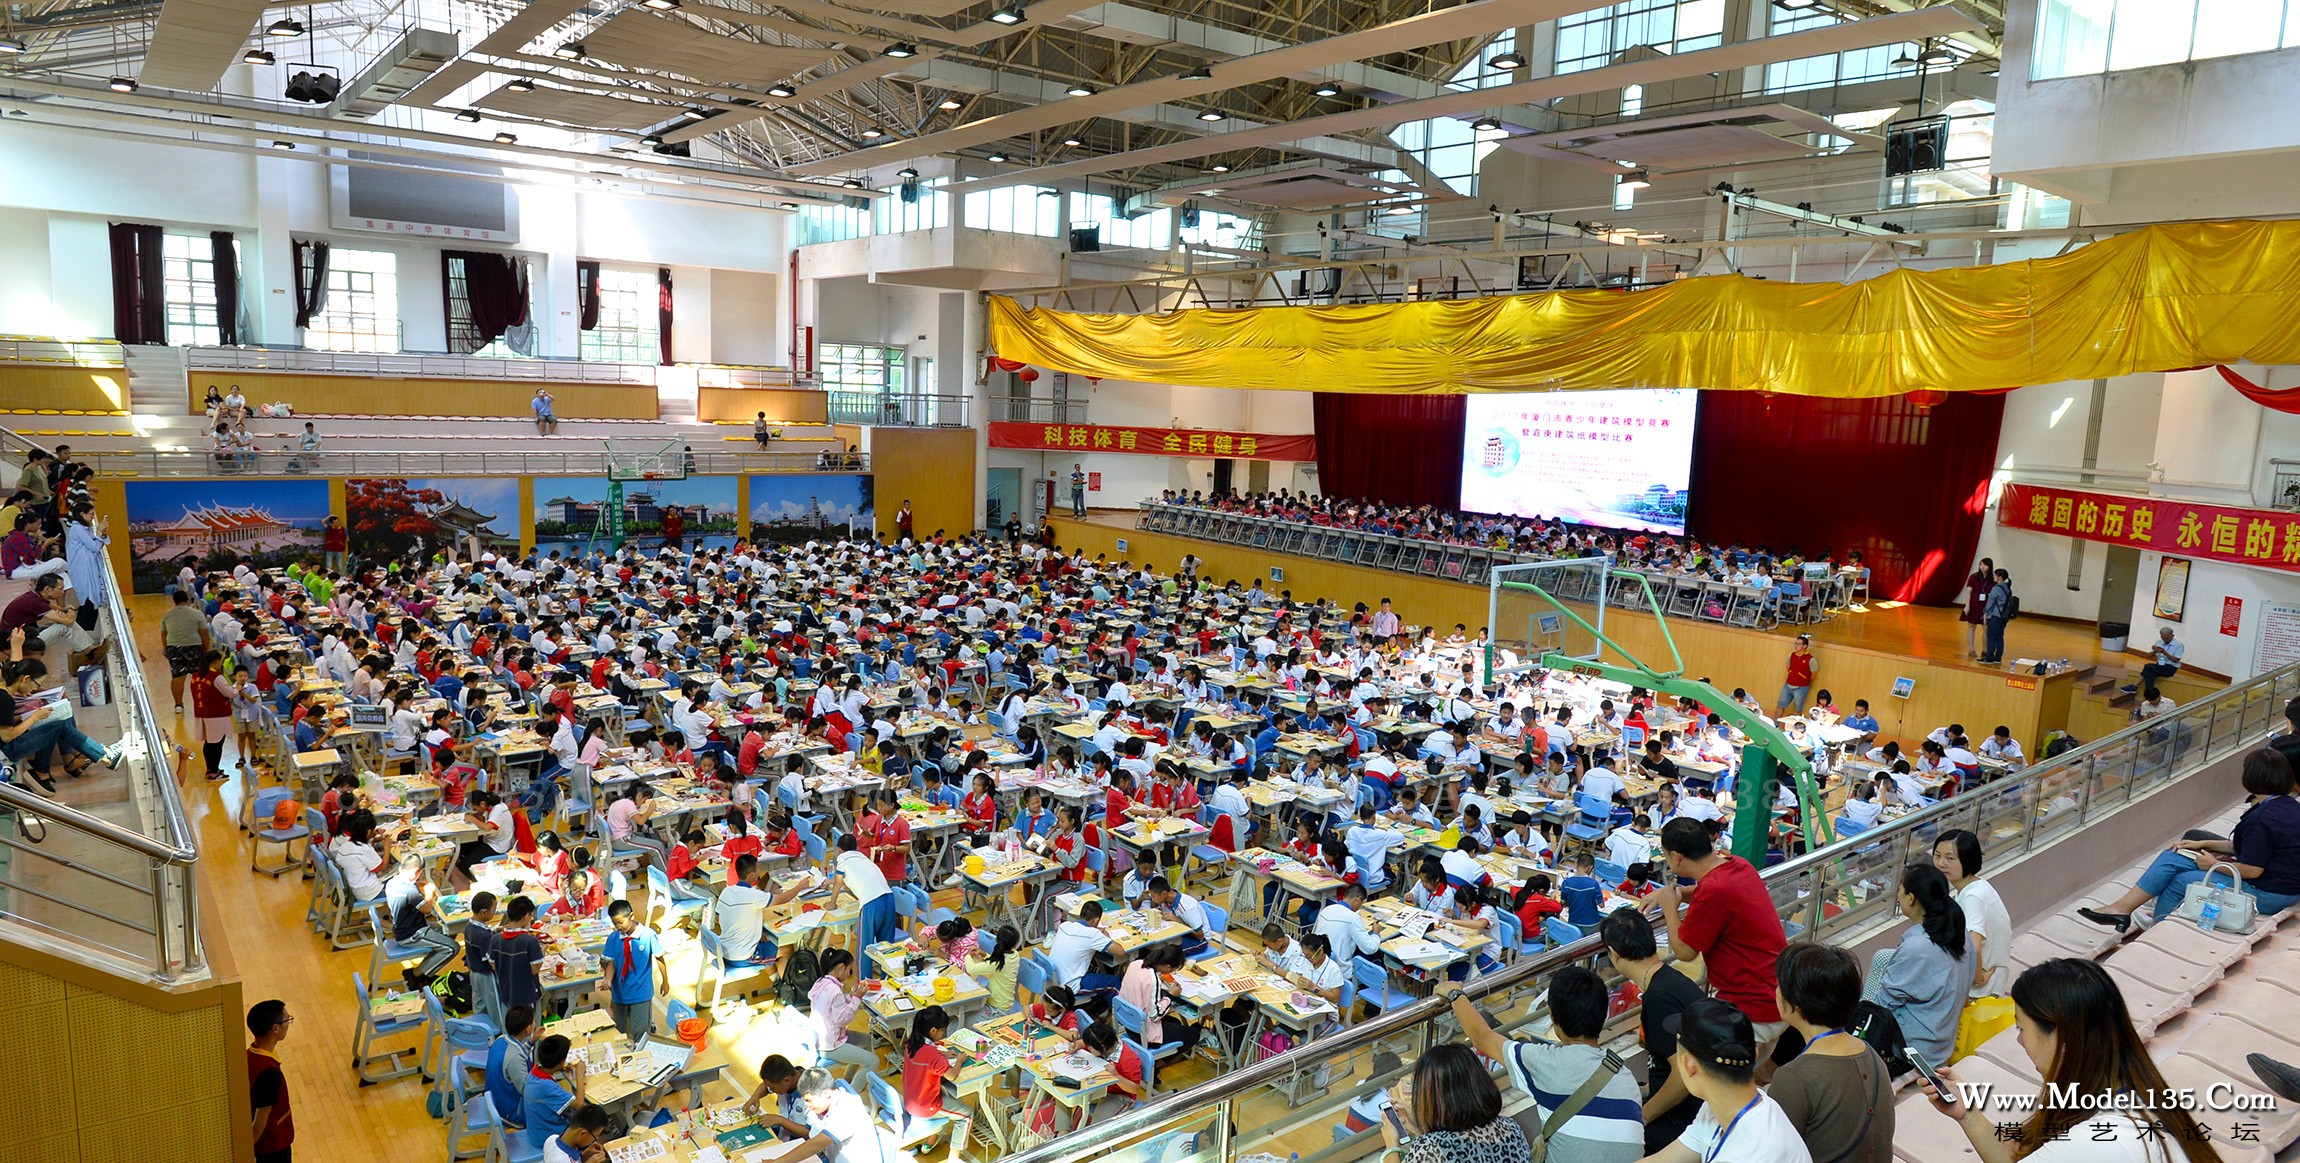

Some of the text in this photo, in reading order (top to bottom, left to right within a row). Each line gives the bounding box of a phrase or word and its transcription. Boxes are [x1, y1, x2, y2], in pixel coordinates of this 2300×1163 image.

[366, 220, 490, 239] 集美中学体育馆
[1044, 426, 1259, 456] 科技体育 全民健身
[2028, 493, 2154, 543] 凝固的历史
